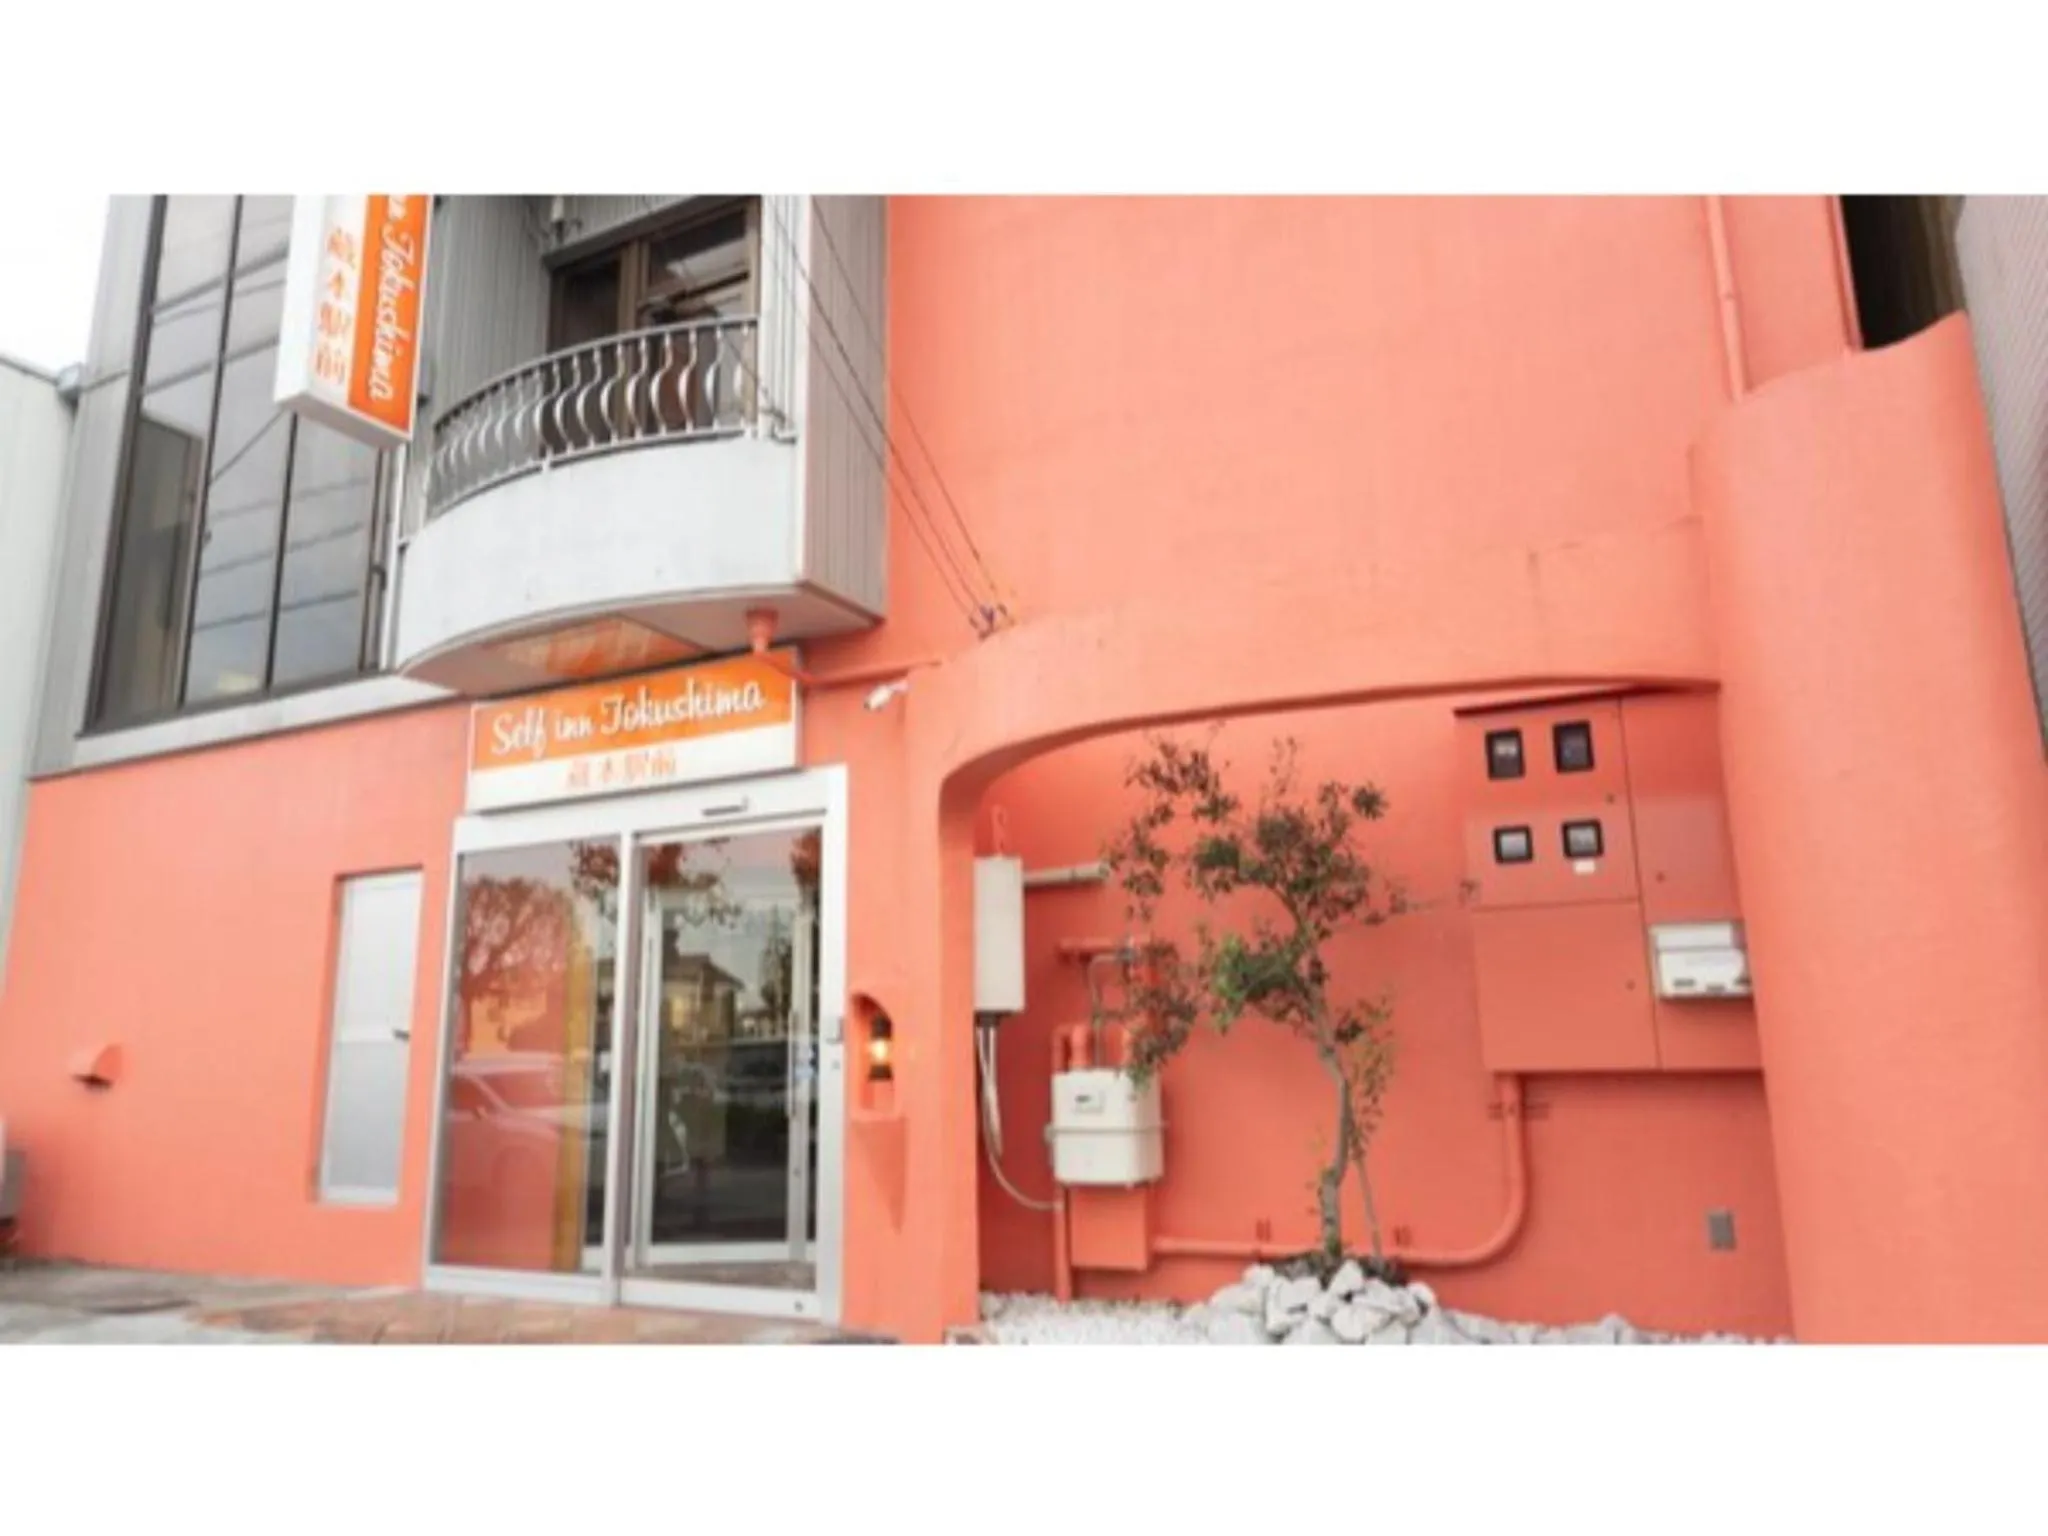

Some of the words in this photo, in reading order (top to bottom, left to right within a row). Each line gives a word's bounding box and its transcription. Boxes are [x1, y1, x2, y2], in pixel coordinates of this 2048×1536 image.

[491, 706, 545, 757] Self
[554, 709, 593, 741] inn
[600, 677, 763, 735] Tokushima
